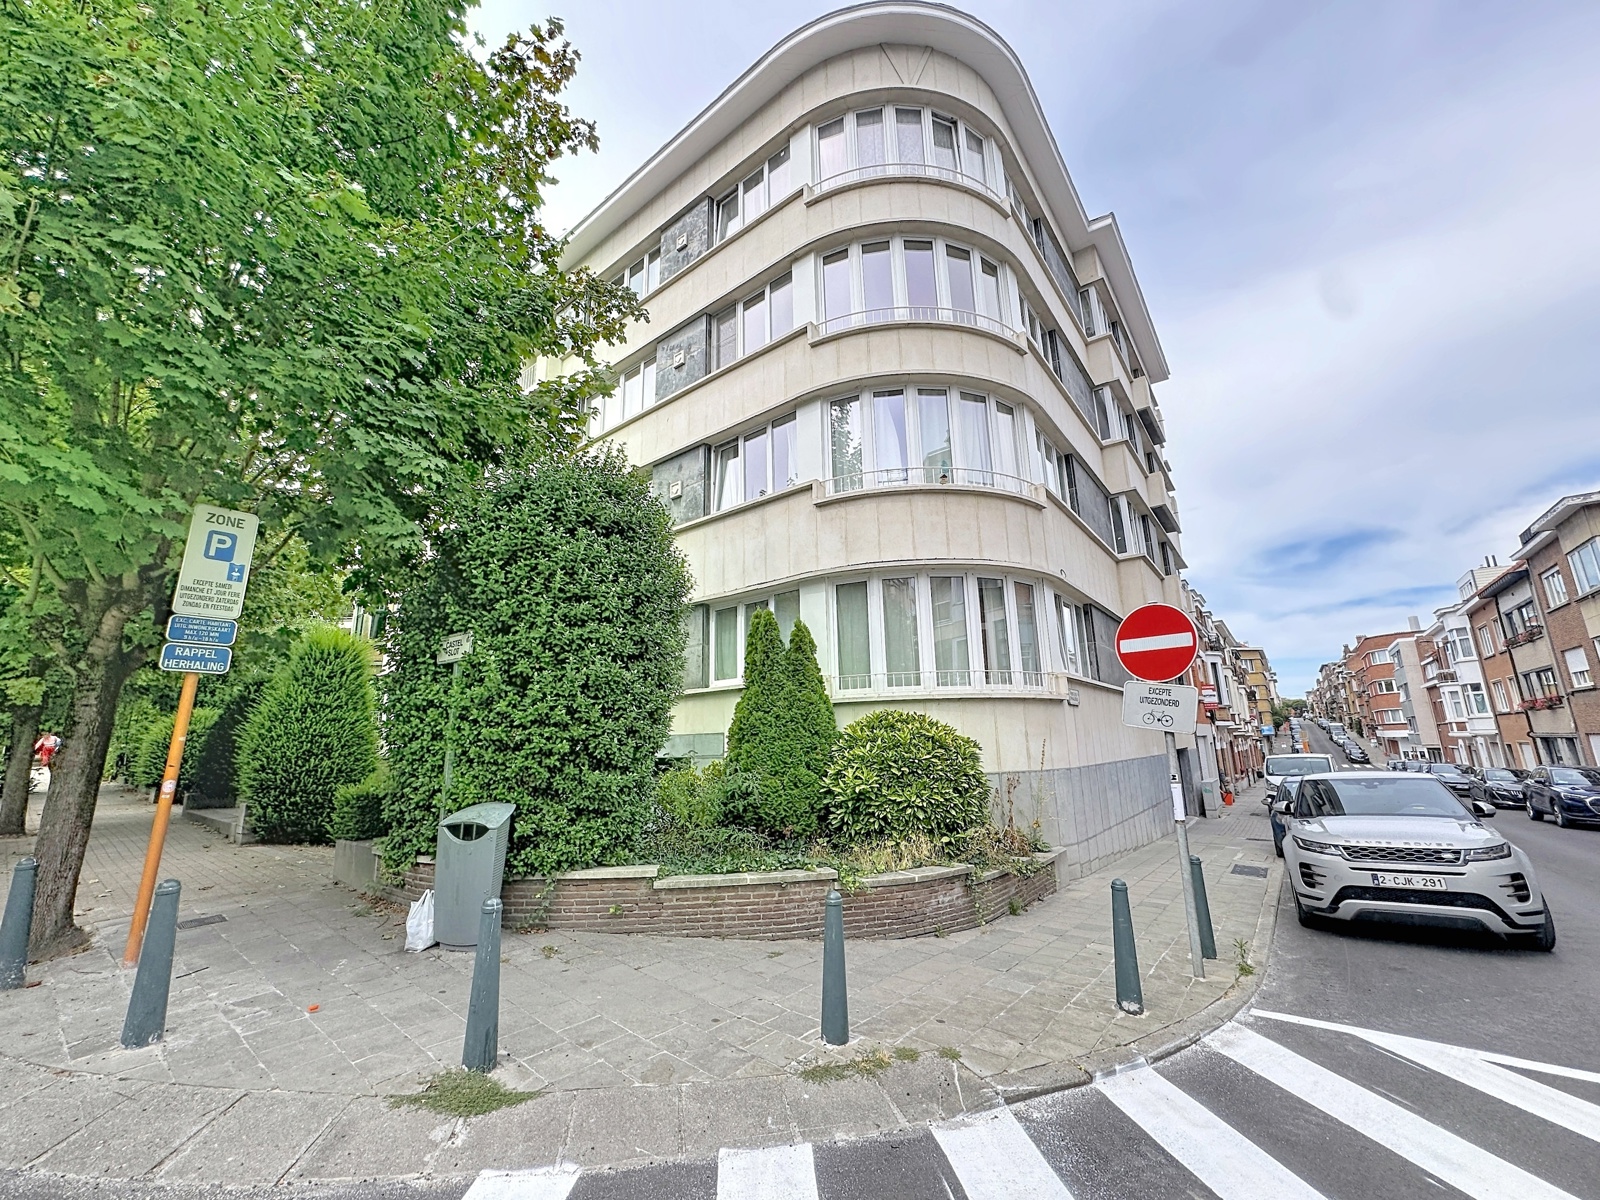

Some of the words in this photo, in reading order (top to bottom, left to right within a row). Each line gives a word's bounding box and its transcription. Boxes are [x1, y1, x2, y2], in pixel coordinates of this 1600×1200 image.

[205, 512, 246, 529] ZONE
[208, 533, 232, 556] P
[180, 585, 205, 594] DIMANCHE
[213, 589, 227, 597] JOUR
[214, 582, 233, 590] SAMEDI
[179, 592, 215, 602] UITGEZONDERD
[215, 597, 239, 605] ZATERDAG
[182, 600, 202, 609] ZONDAG
[210, 603, 234, 612] FEESTDAG
[446, 639, 463, 648] CASTEL
[174, 646, 218, 659] RAPPEL
[163, 658, 225, 671] HERHALING
[1148, 687, 1172, 697] EXCEPTE
[1139, 696, 1180, 707] UITGEZONDERD
[1379, 875, 1444, 888] 2-CJK-291
